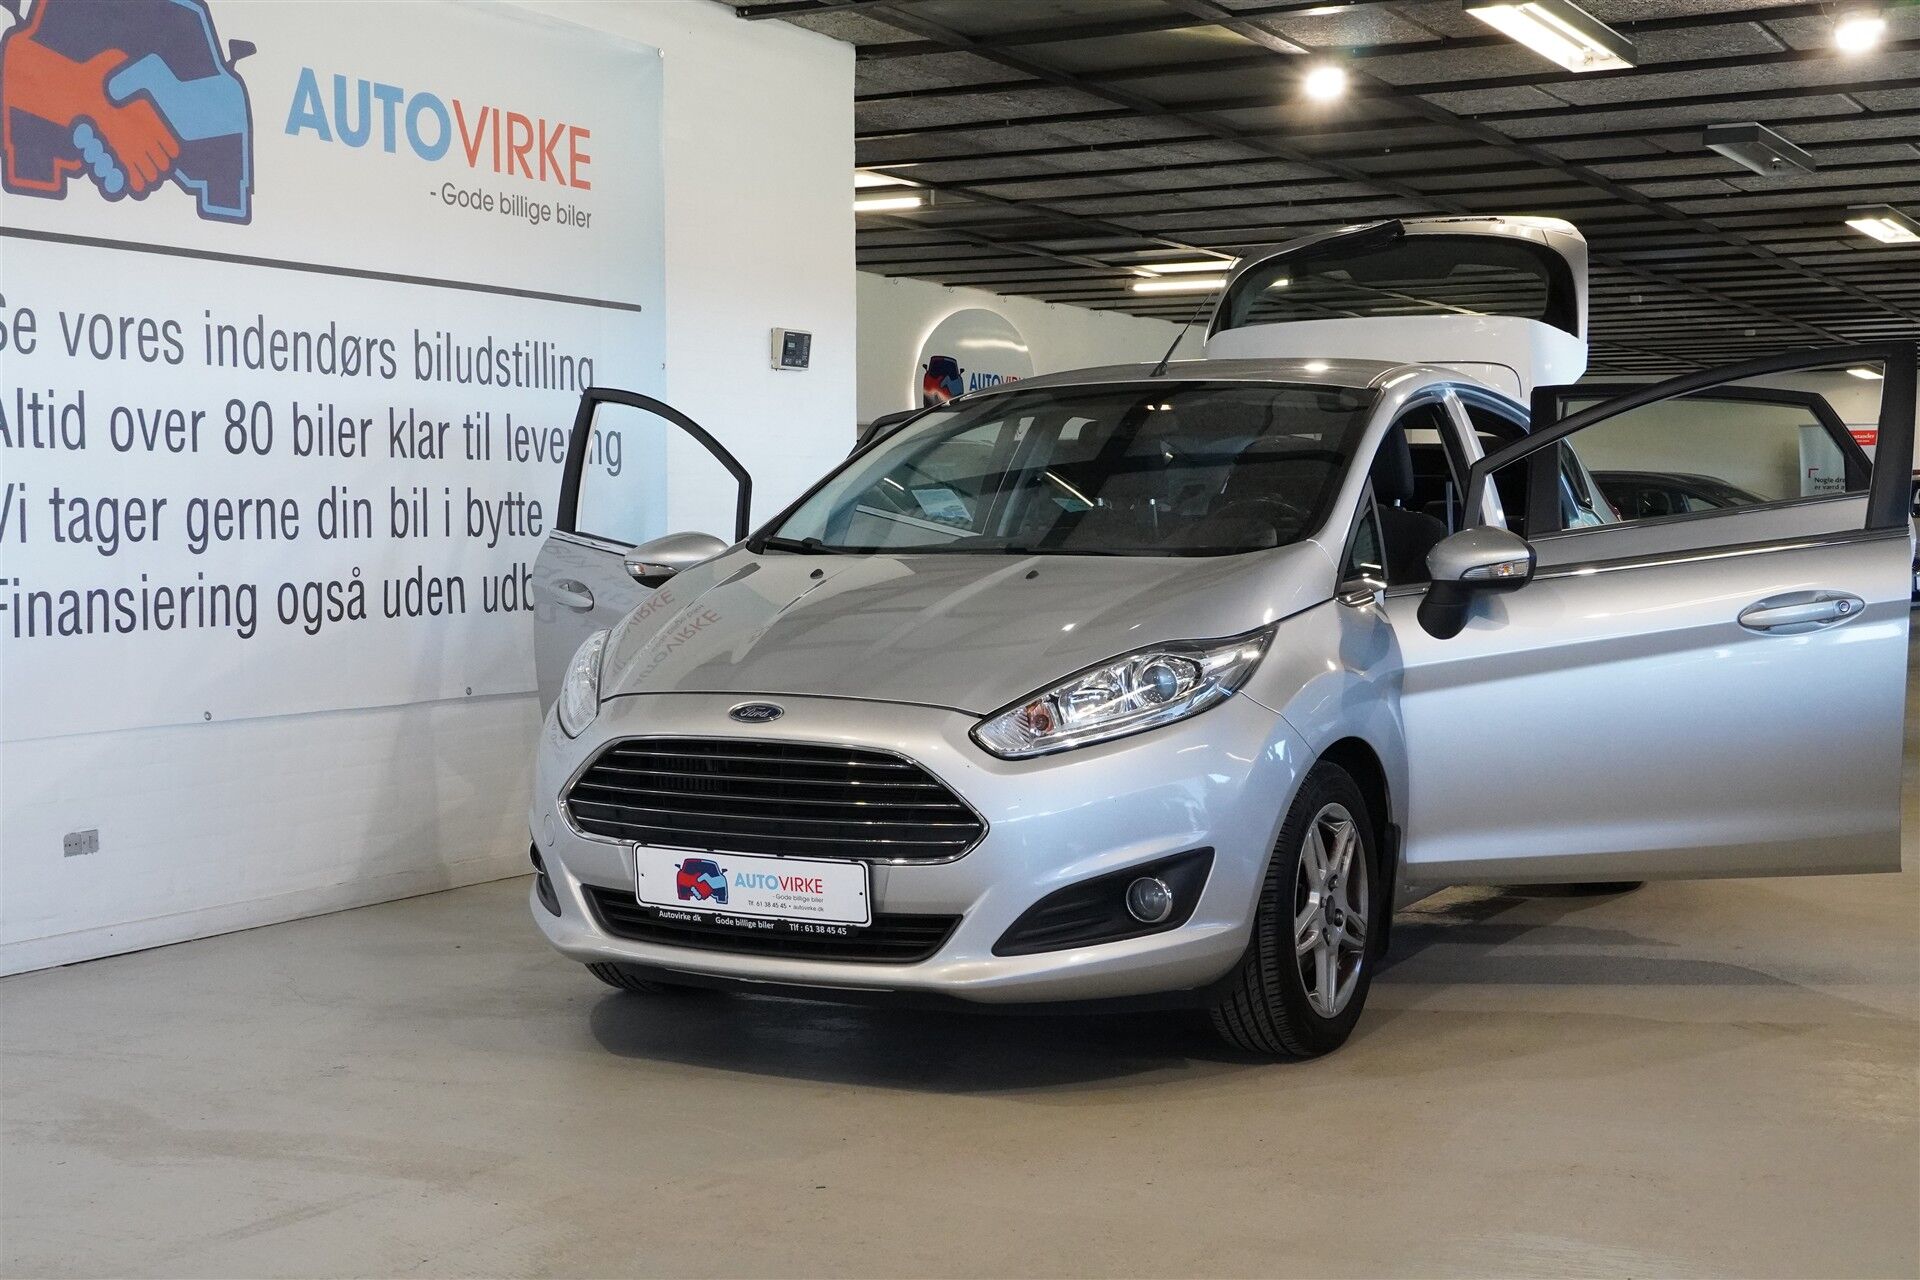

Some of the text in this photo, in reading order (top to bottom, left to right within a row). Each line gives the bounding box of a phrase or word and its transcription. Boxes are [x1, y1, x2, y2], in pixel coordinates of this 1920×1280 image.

[284, 66, 592, 191] AUTOVIRKE
[441, 181, 494, 212] Gode
[499, 191, 551, 225] billige
[556, 202, 592, 229] biler
[58, 310, 185, 367] vores
[204, 309, 398, 380] indendørs
[414, 326, 594, 398] biludstilling
[109, 408, 206, 456] over
[224, 400, 274, 457] 80
[293, 403, 373, 460] biler
[389, 406, 450, 462] klar
[463, 413, 491, 462] til
[49, 488, 168, 556] tager
[186, 490, 300, 554] gerne
[317, 485, 373, 541] din
[390, 485, 429, 539] bil
[444, 487, 452, 538] i
[466, 489, 544, 548] bytte
[277, 567, 367, 636] også
[383, 562, 467, 618] uden
[734, 872, 824, 895] AUTOVIRKE
[775, 893, 792, 901] Gode
[715, 916, 734, 926] Gode
[735, 918, 757, 929] billige
[758, 920, 775, 929] biler
[805, 924, 814, 933] 61
[816, 925, 825, 933] 38
[826, 926, 836, 935] 45
[837, 927, 847, 935] 45
